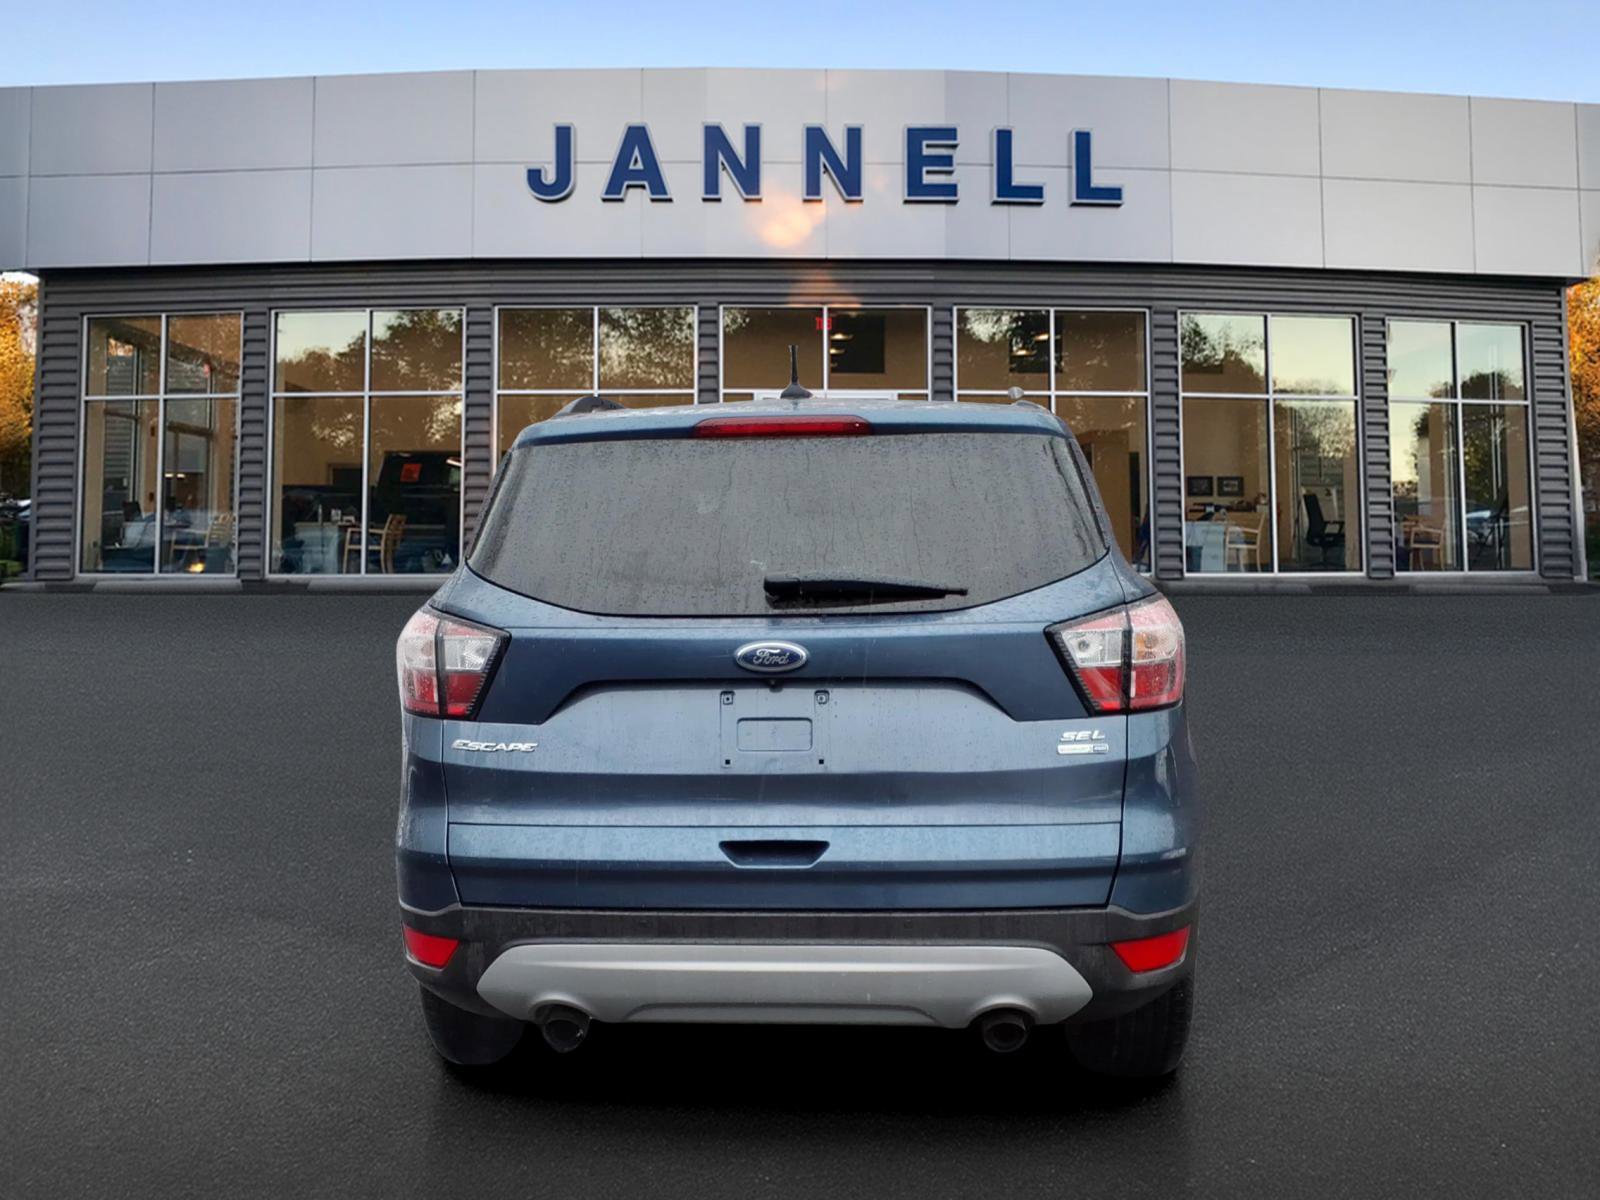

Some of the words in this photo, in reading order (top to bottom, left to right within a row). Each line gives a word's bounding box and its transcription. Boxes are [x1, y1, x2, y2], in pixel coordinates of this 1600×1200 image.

[525, 122, 1124, 206] JANNELL
[752, 647, 790, 665] Ford
[1060, 730, 1106, 742] SEL
[452, 739, 539, 753] ESCAPE
